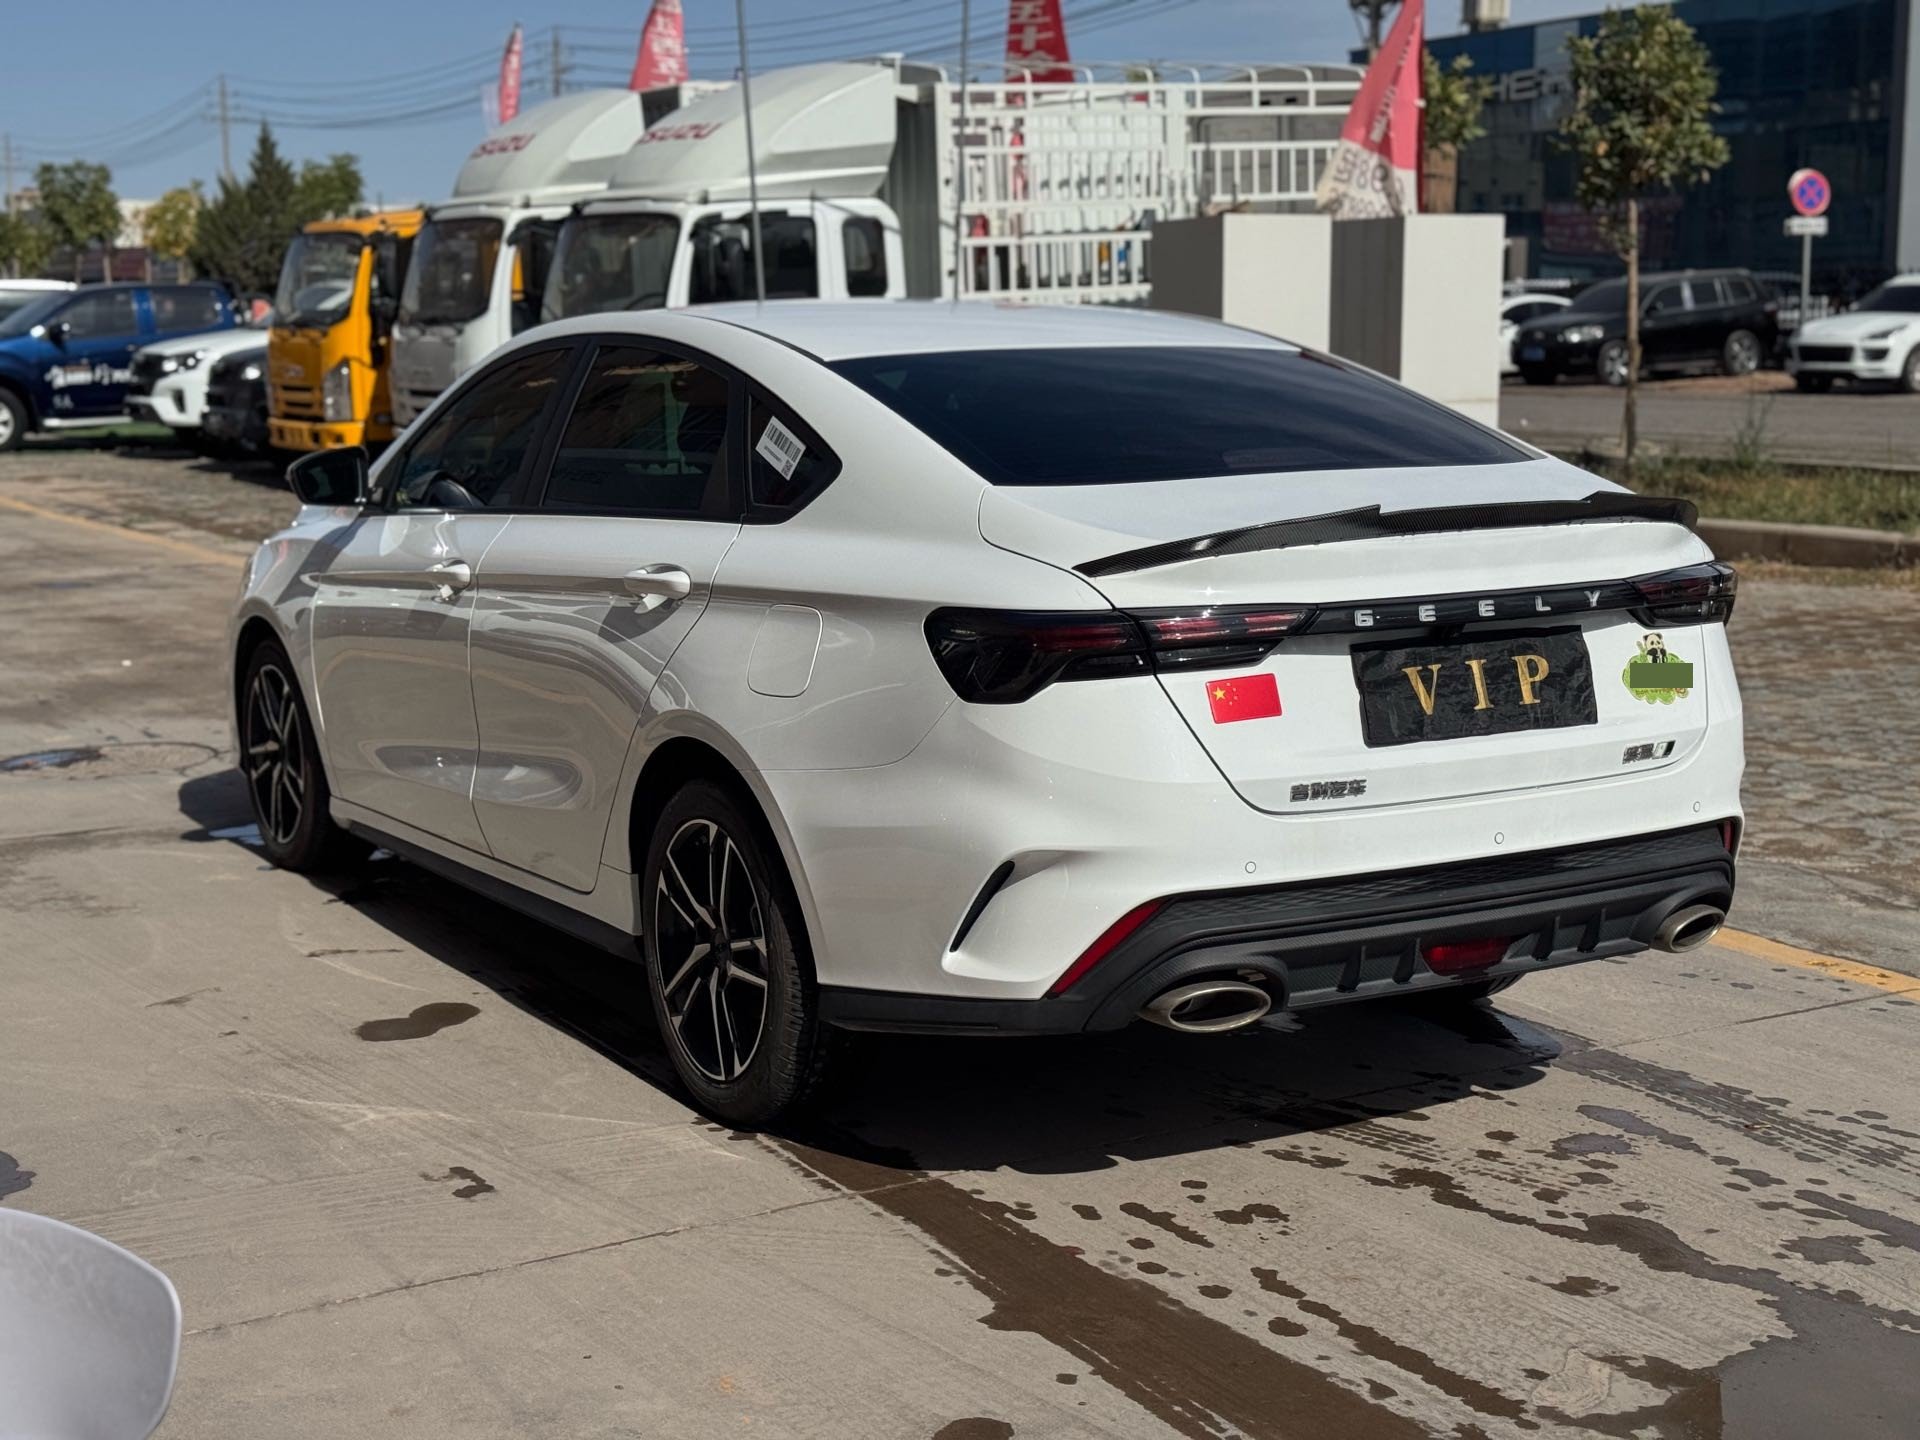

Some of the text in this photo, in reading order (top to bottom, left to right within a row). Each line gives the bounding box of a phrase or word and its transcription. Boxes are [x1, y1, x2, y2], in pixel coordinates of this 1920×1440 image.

[638, 123, 722, 145] ISUZU
[1354, 590, 1602, 628] GEELY
[1401, 653, 1551, 717] VIP
[1289, 778, 1368, 803] 吉利汽车
